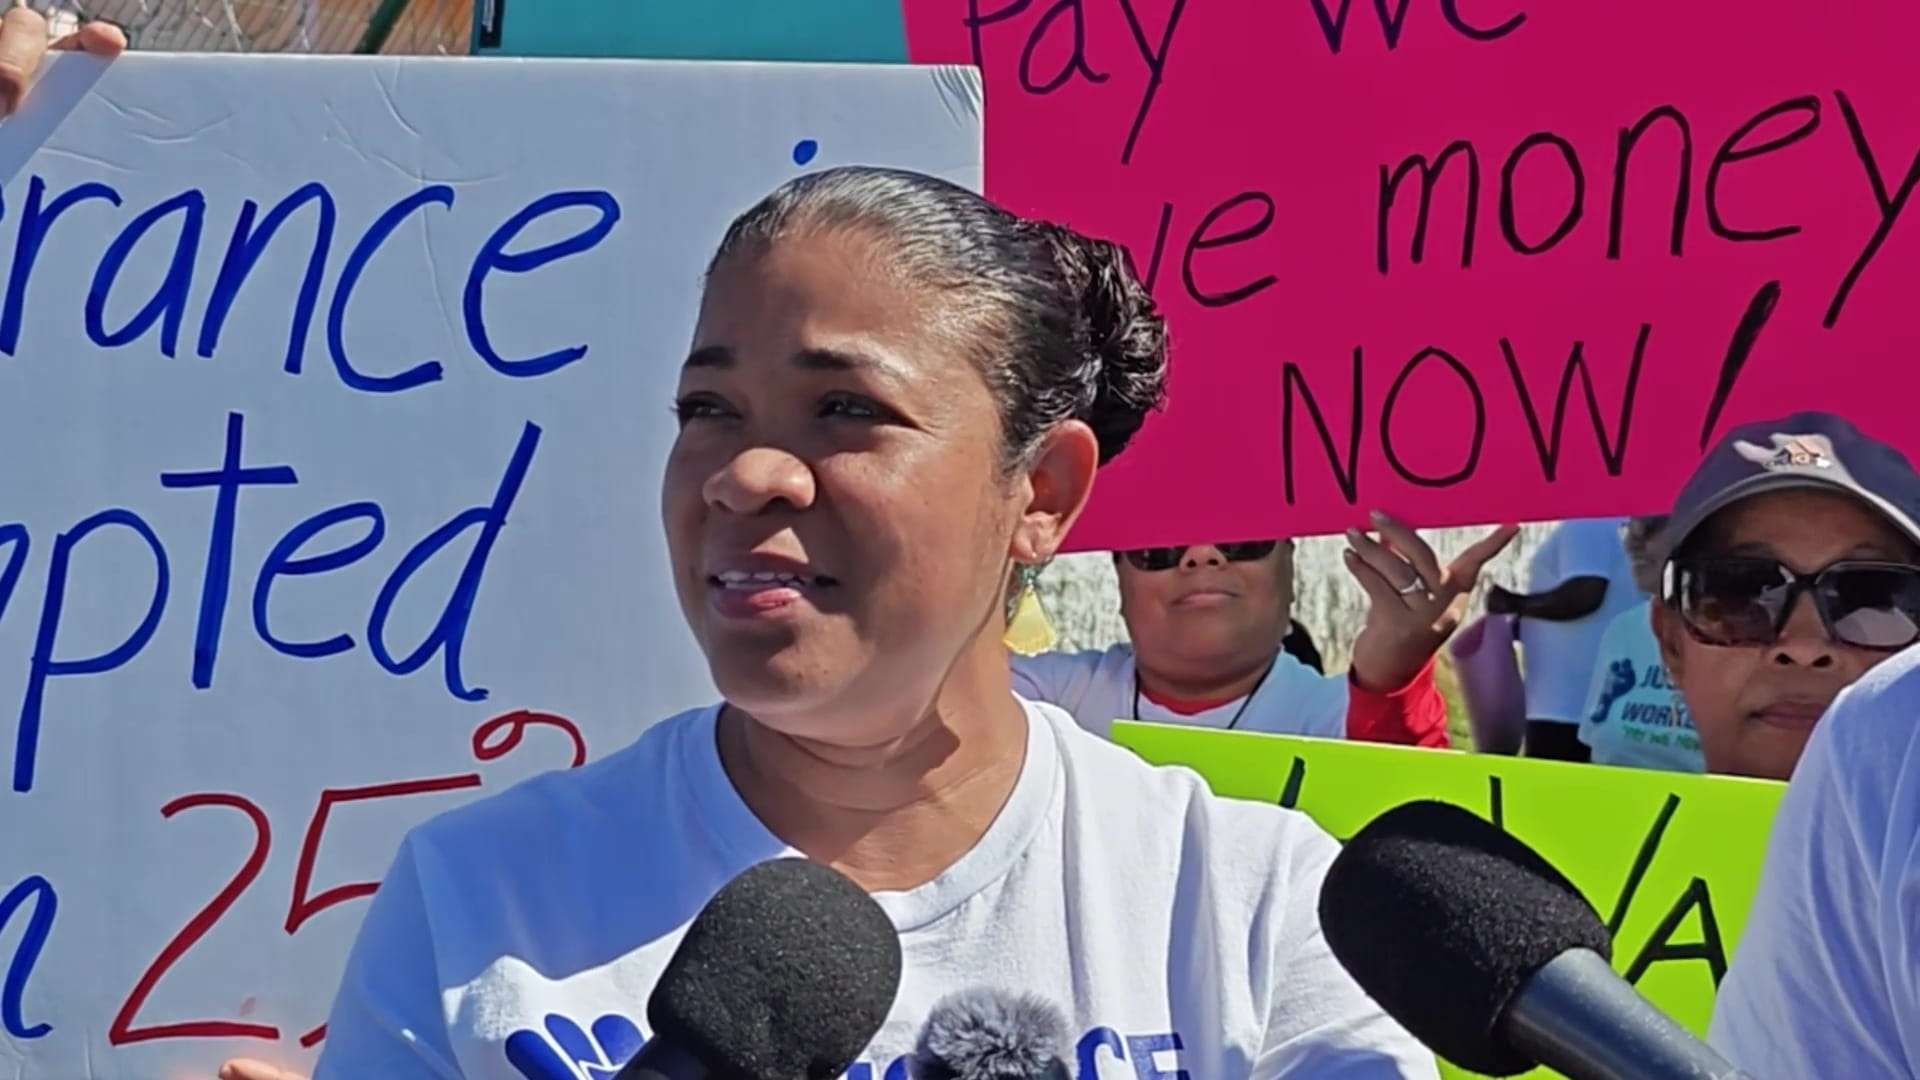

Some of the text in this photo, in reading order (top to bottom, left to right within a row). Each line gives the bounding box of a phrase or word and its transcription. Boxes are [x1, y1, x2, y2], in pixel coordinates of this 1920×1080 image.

[0, 174, 621, 392] rance
[1377, 90, 1920, 329] money
[1283, 280, 1781, 506] NOW!
